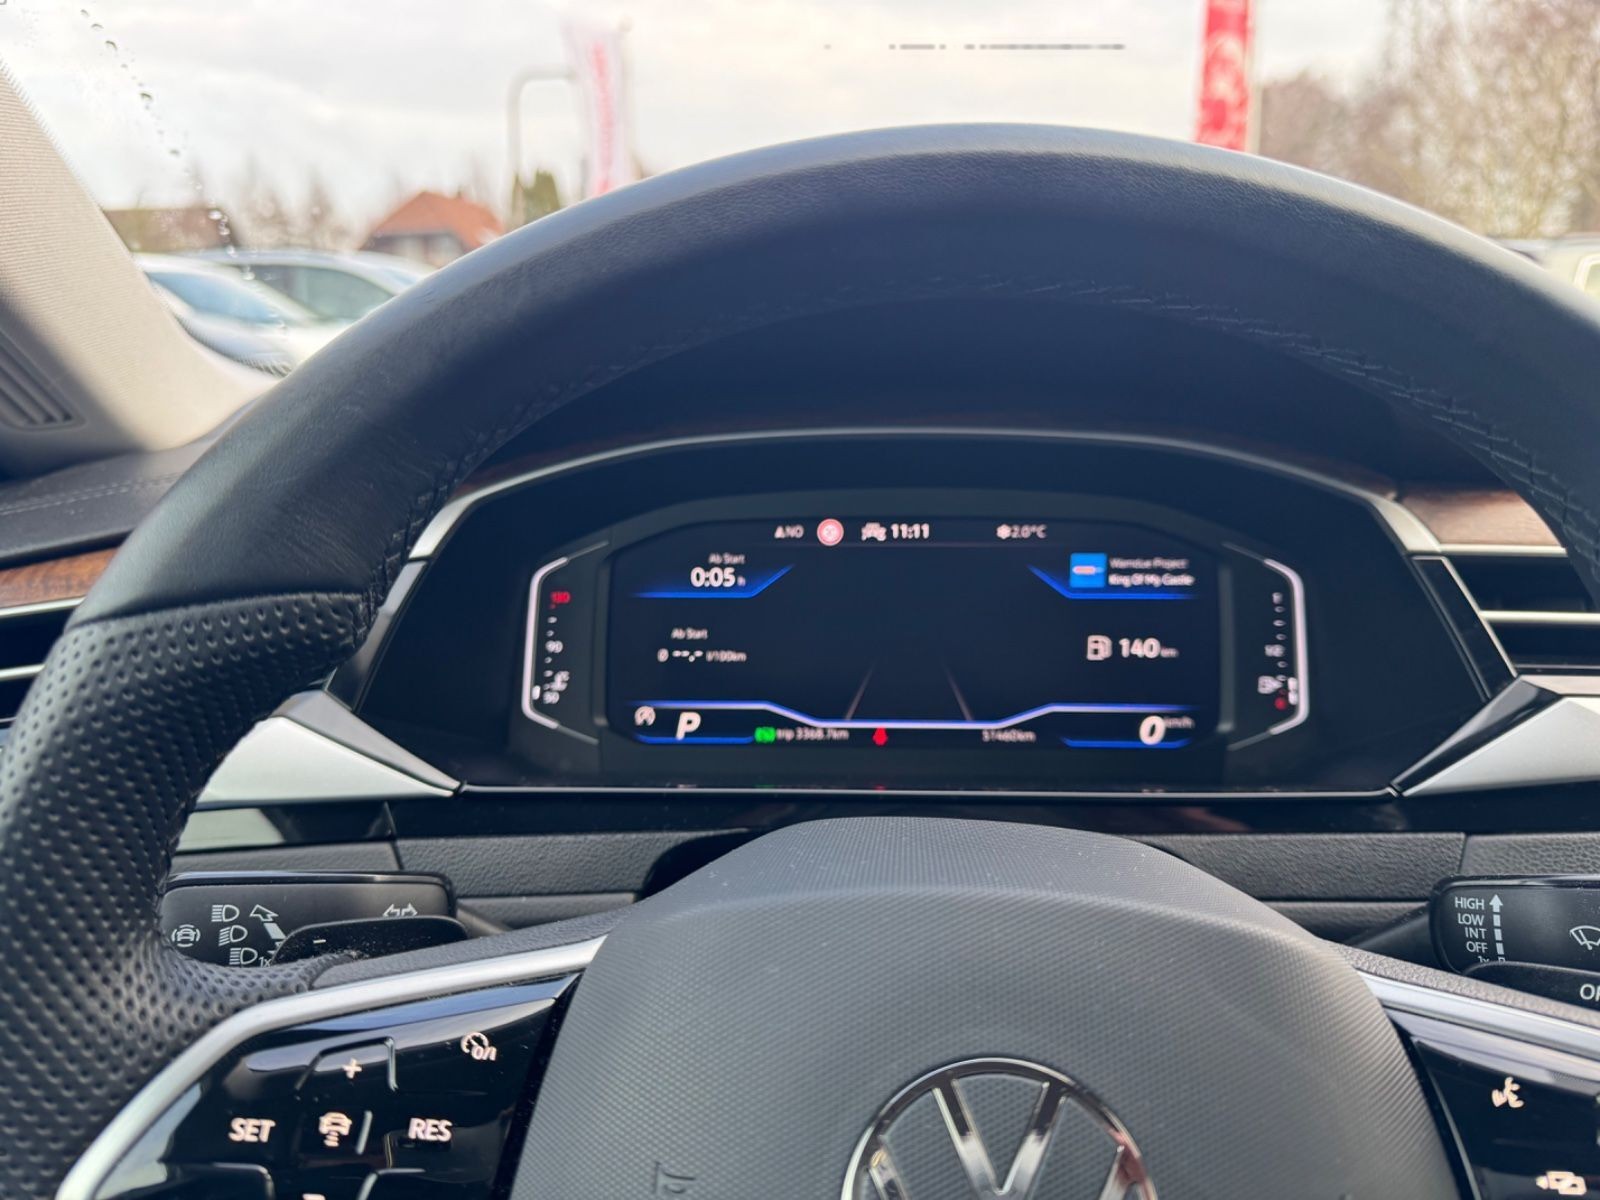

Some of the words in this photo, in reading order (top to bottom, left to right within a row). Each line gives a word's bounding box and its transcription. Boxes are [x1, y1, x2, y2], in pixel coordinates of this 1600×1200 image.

[891, 523, 930, 539] 11:11
[690, 567, 736, 587] 0:05
[1119, 637, 1160, 658] 140
[676, 711, 702, 740] P
[1139, 715, 1166, 745] 0
[1454, 896, 1485, 910] HIGH
[1457, 913, 1485, 926] LOW
[1464, 927, 1487, 939] INT
[1466, 941, 1488, 953] OFF
[229, 1117, 276, 1143] SET
[408, 1118, 453, 1142] RES
